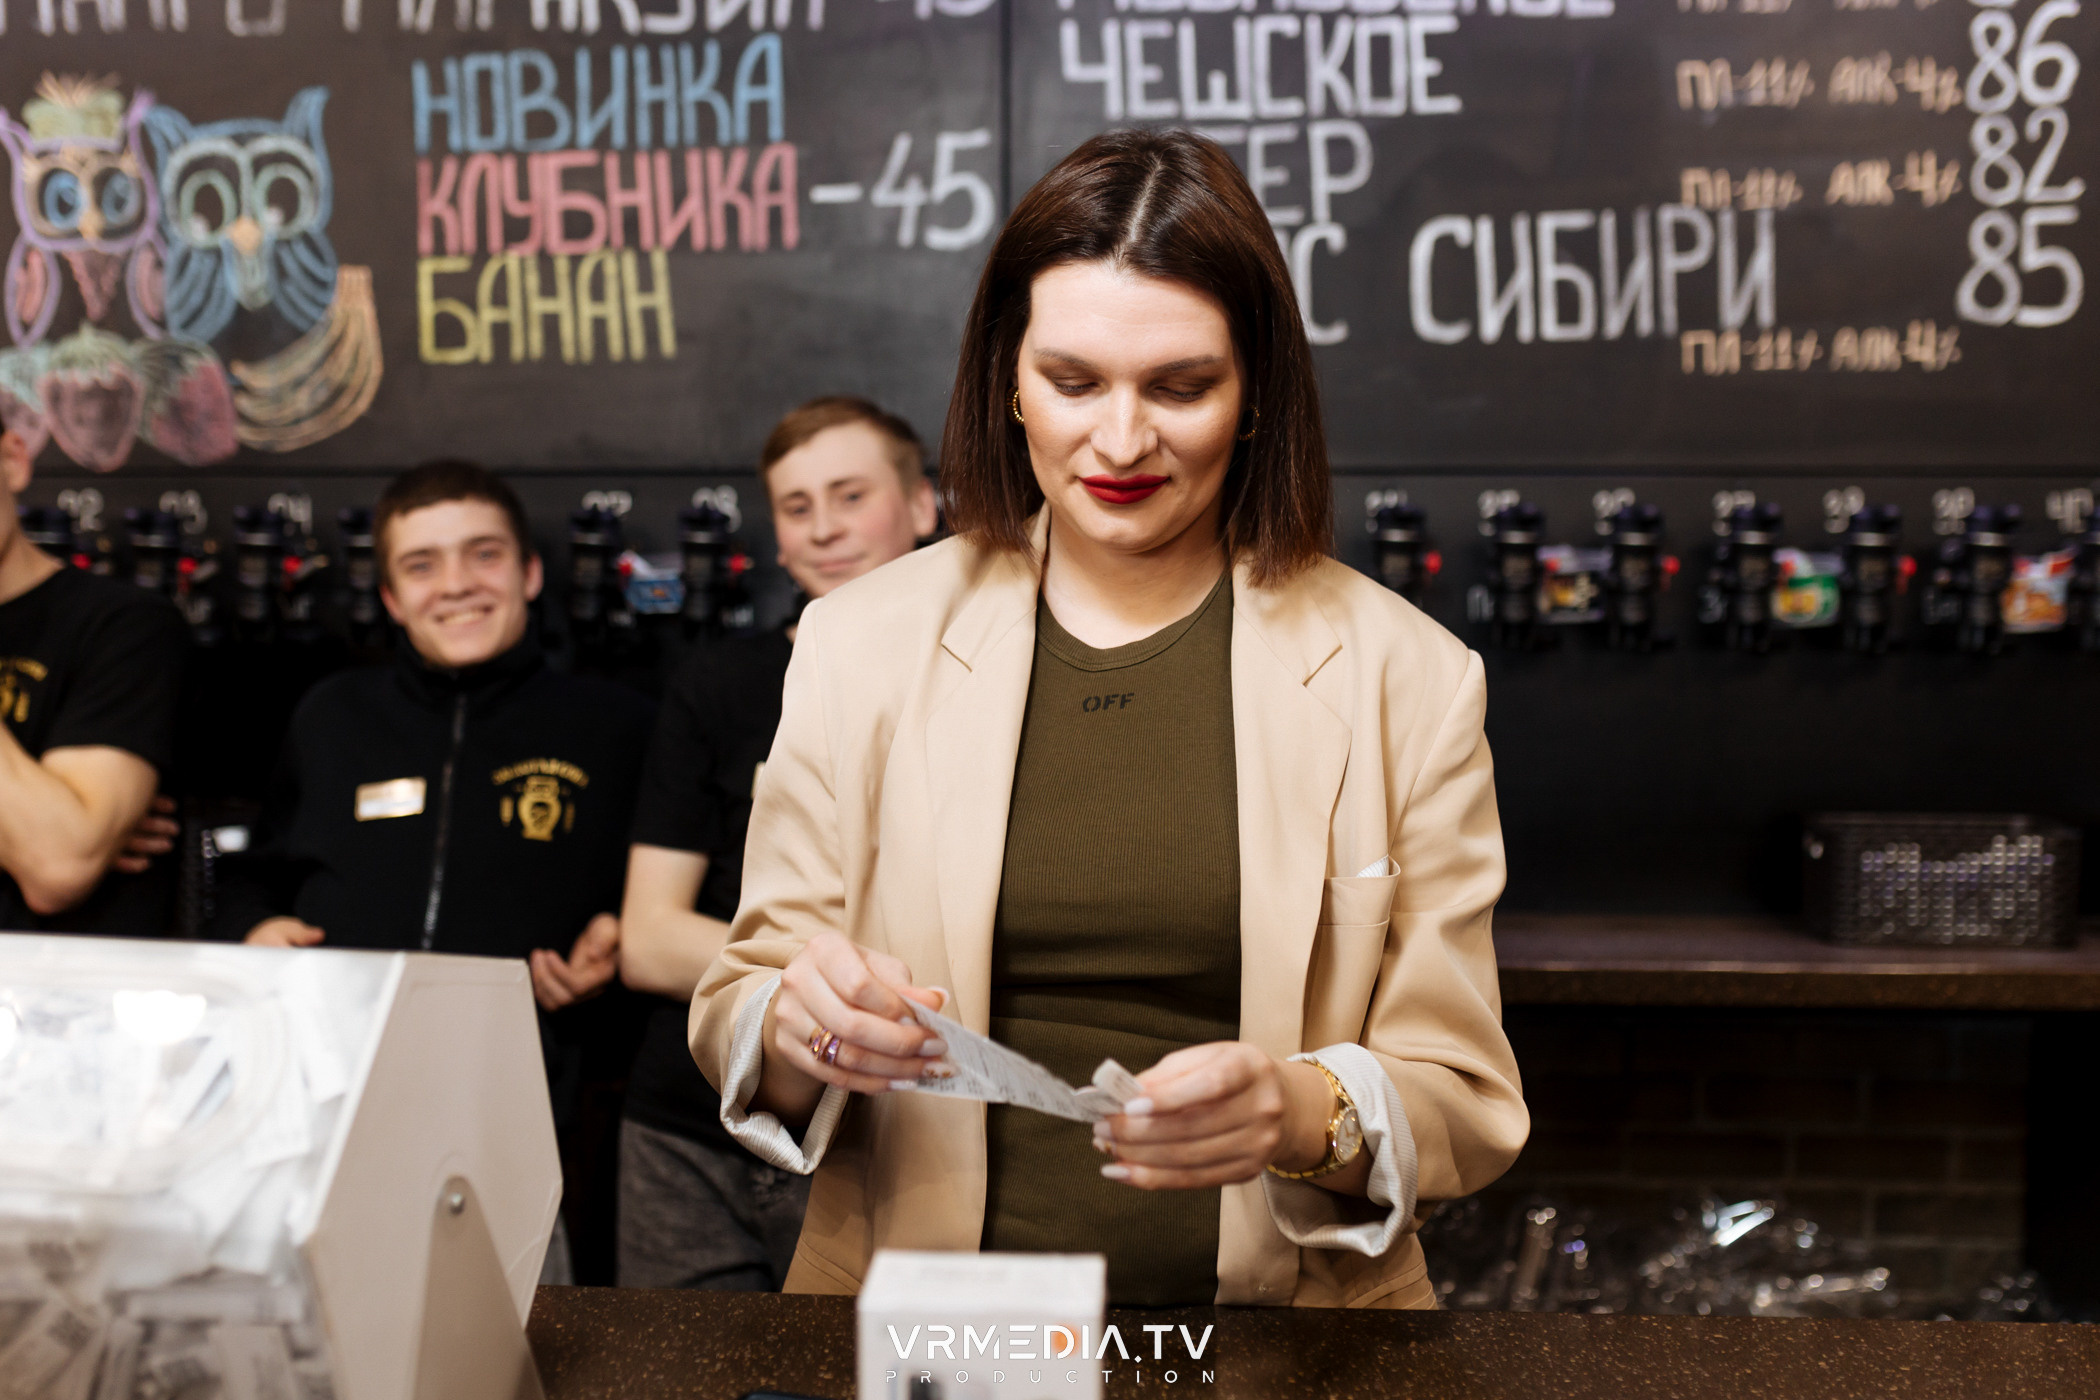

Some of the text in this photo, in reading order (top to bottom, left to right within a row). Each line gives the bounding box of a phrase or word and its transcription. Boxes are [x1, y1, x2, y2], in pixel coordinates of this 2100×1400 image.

[412, 33, 785, 154] НОВИНКА
[1059, 15, 1462, 120] ЧЕШСКОЕ
[1964, 0, 2081, 114] 86
[416, 142, 799, 256] КЛУБНИКА
[1968, 105, 2087, 207] 82
[416, 246, 677, 364] БАНАН
[1409, 203, 1776, 345] СИБИРИ
[1956, 205, 2085, 327] 85
[1082, 692, 1135, 713] OFF
